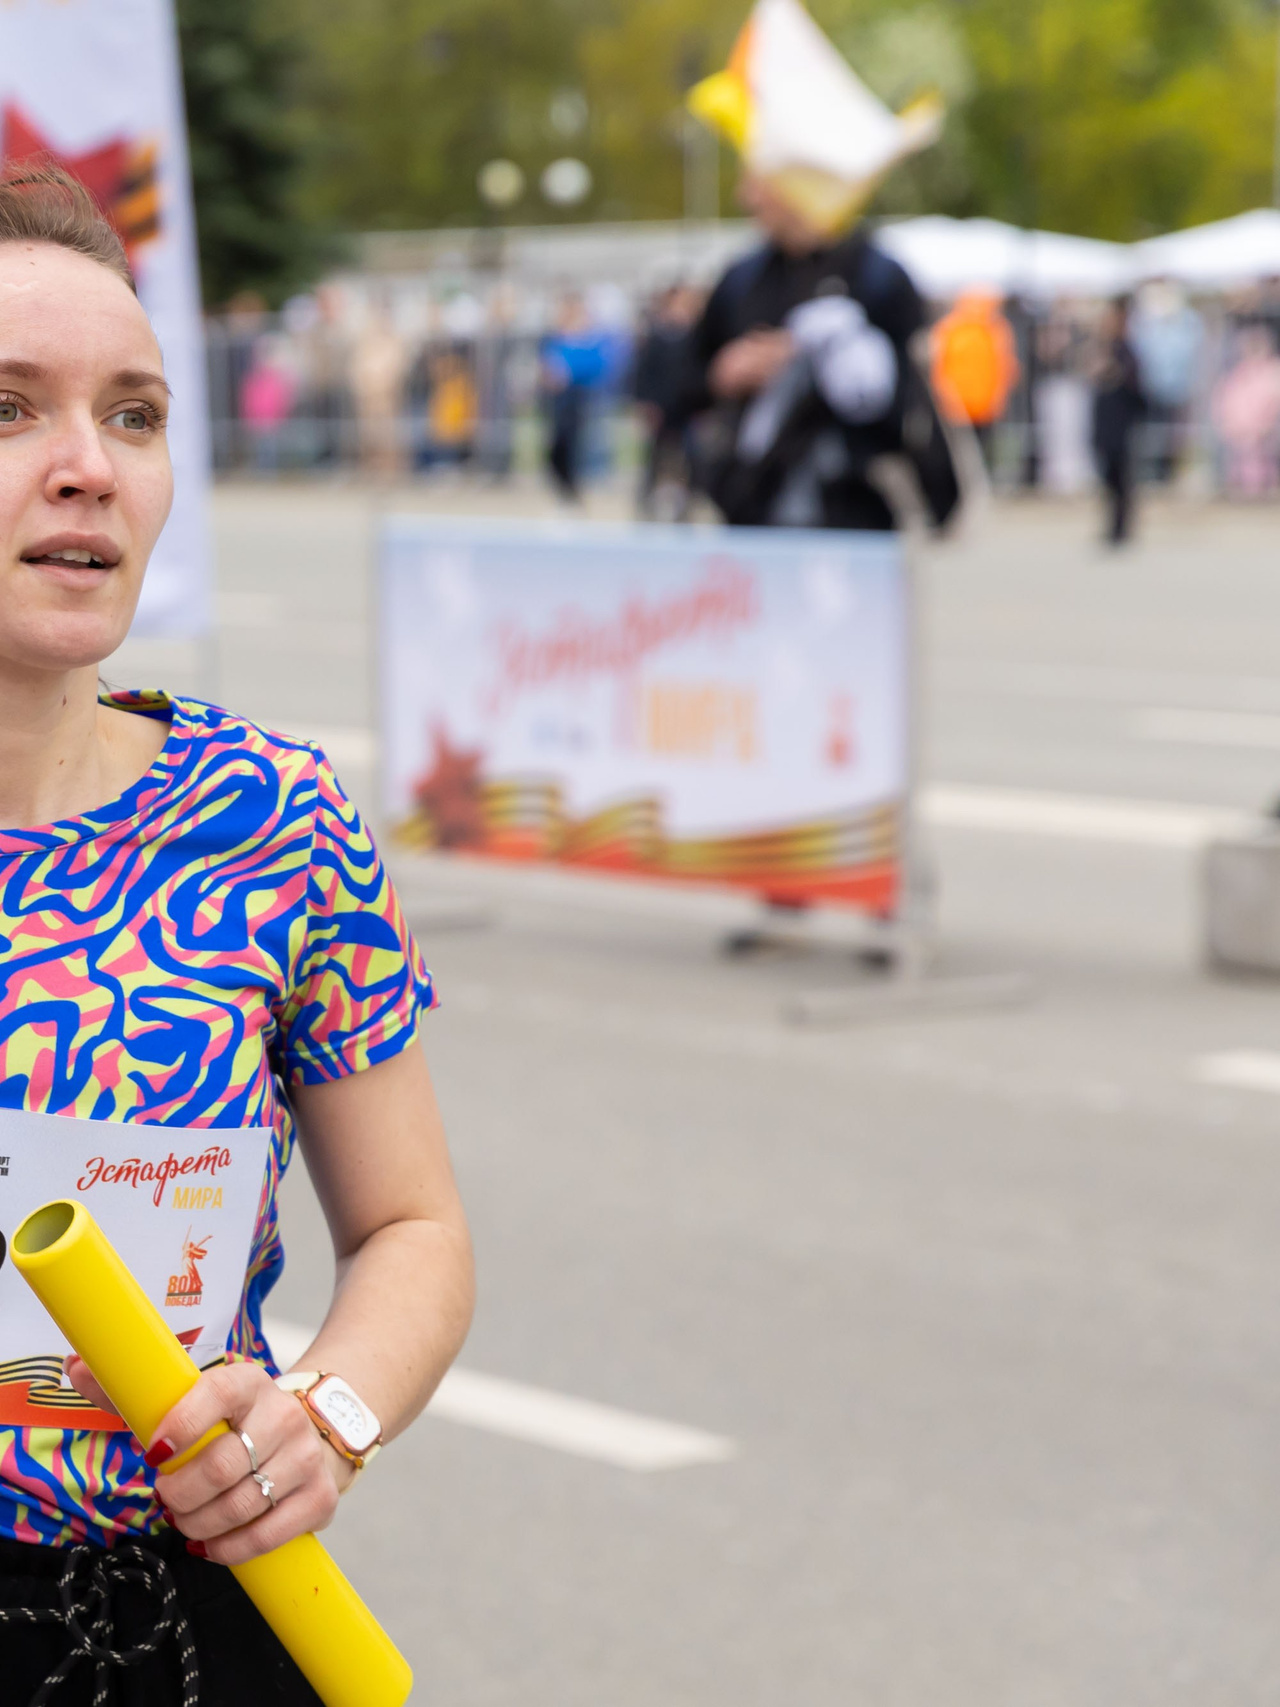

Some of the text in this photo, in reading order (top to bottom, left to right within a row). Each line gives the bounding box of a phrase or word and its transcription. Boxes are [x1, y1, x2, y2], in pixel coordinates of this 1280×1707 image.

[76, 1146, 232, 1207] Эстафета
[172, 1187, 223, 1210] МИРА
[167, 1275, 189, 1293] 80
[165, 1296, 202, 1307] ПОБЕДА!
